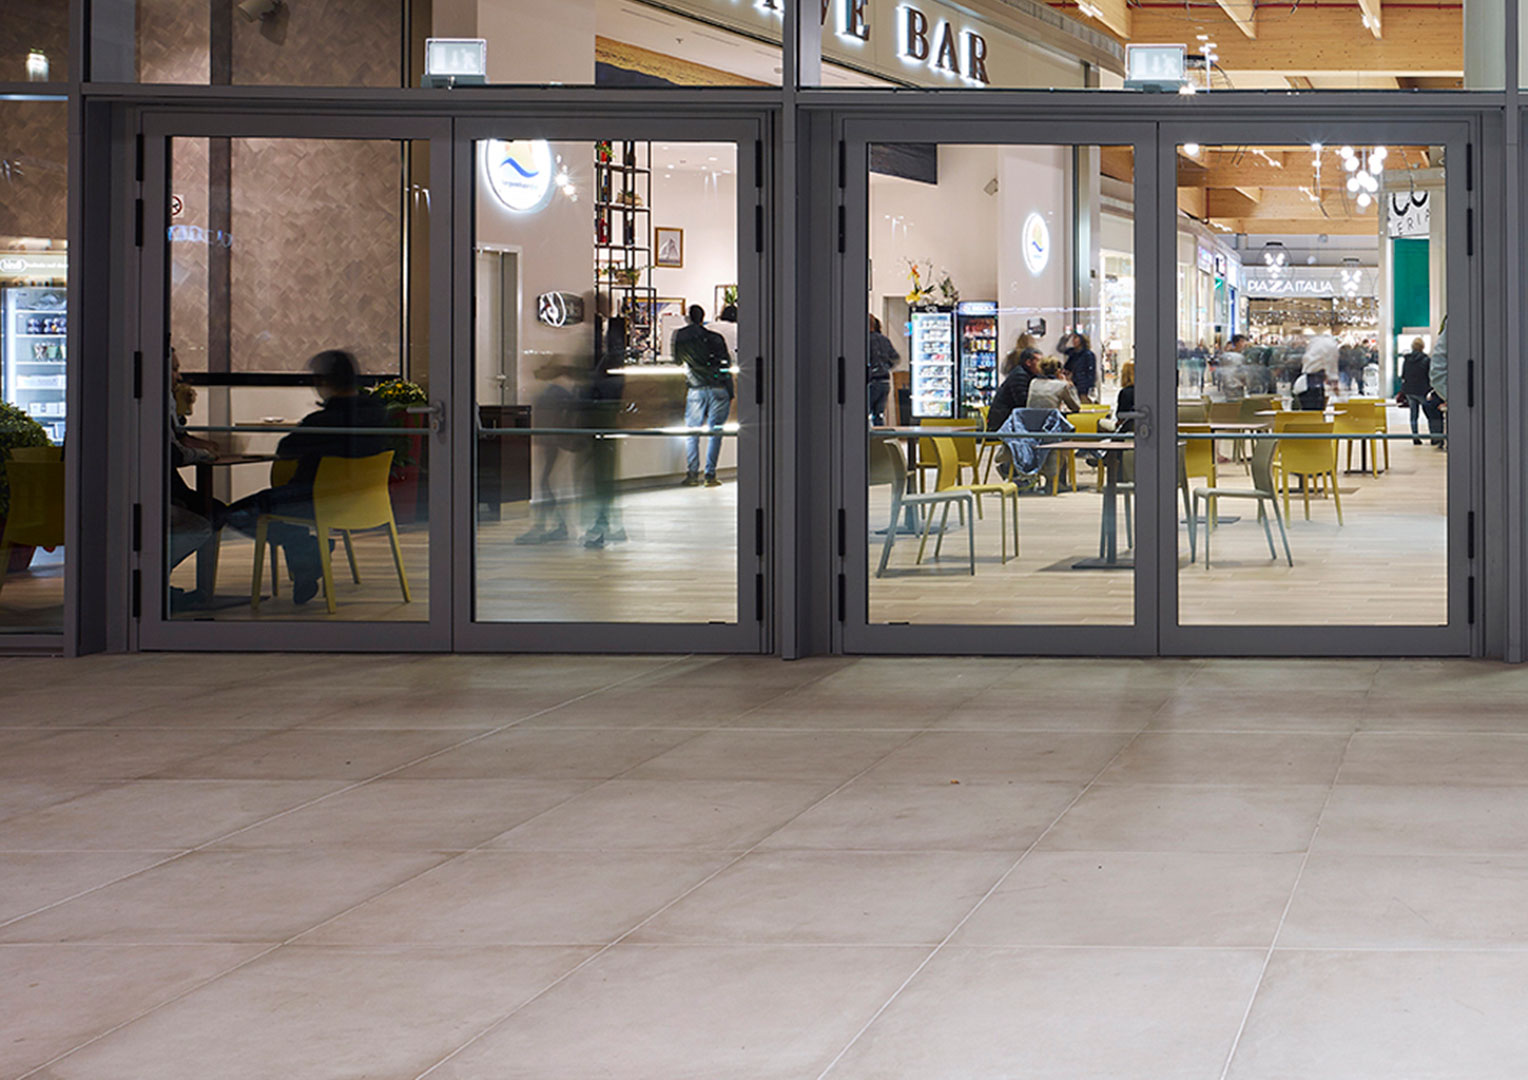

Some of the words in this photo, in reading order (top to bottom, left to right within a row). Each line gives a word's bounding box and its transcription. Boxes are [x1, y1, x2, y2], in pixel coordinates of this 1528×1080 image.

[901, 5, 990, 85] BAR
[1247, 280, 1294, 293] PIAZZA
[1295, 280, 1334, 293] ITALIA
